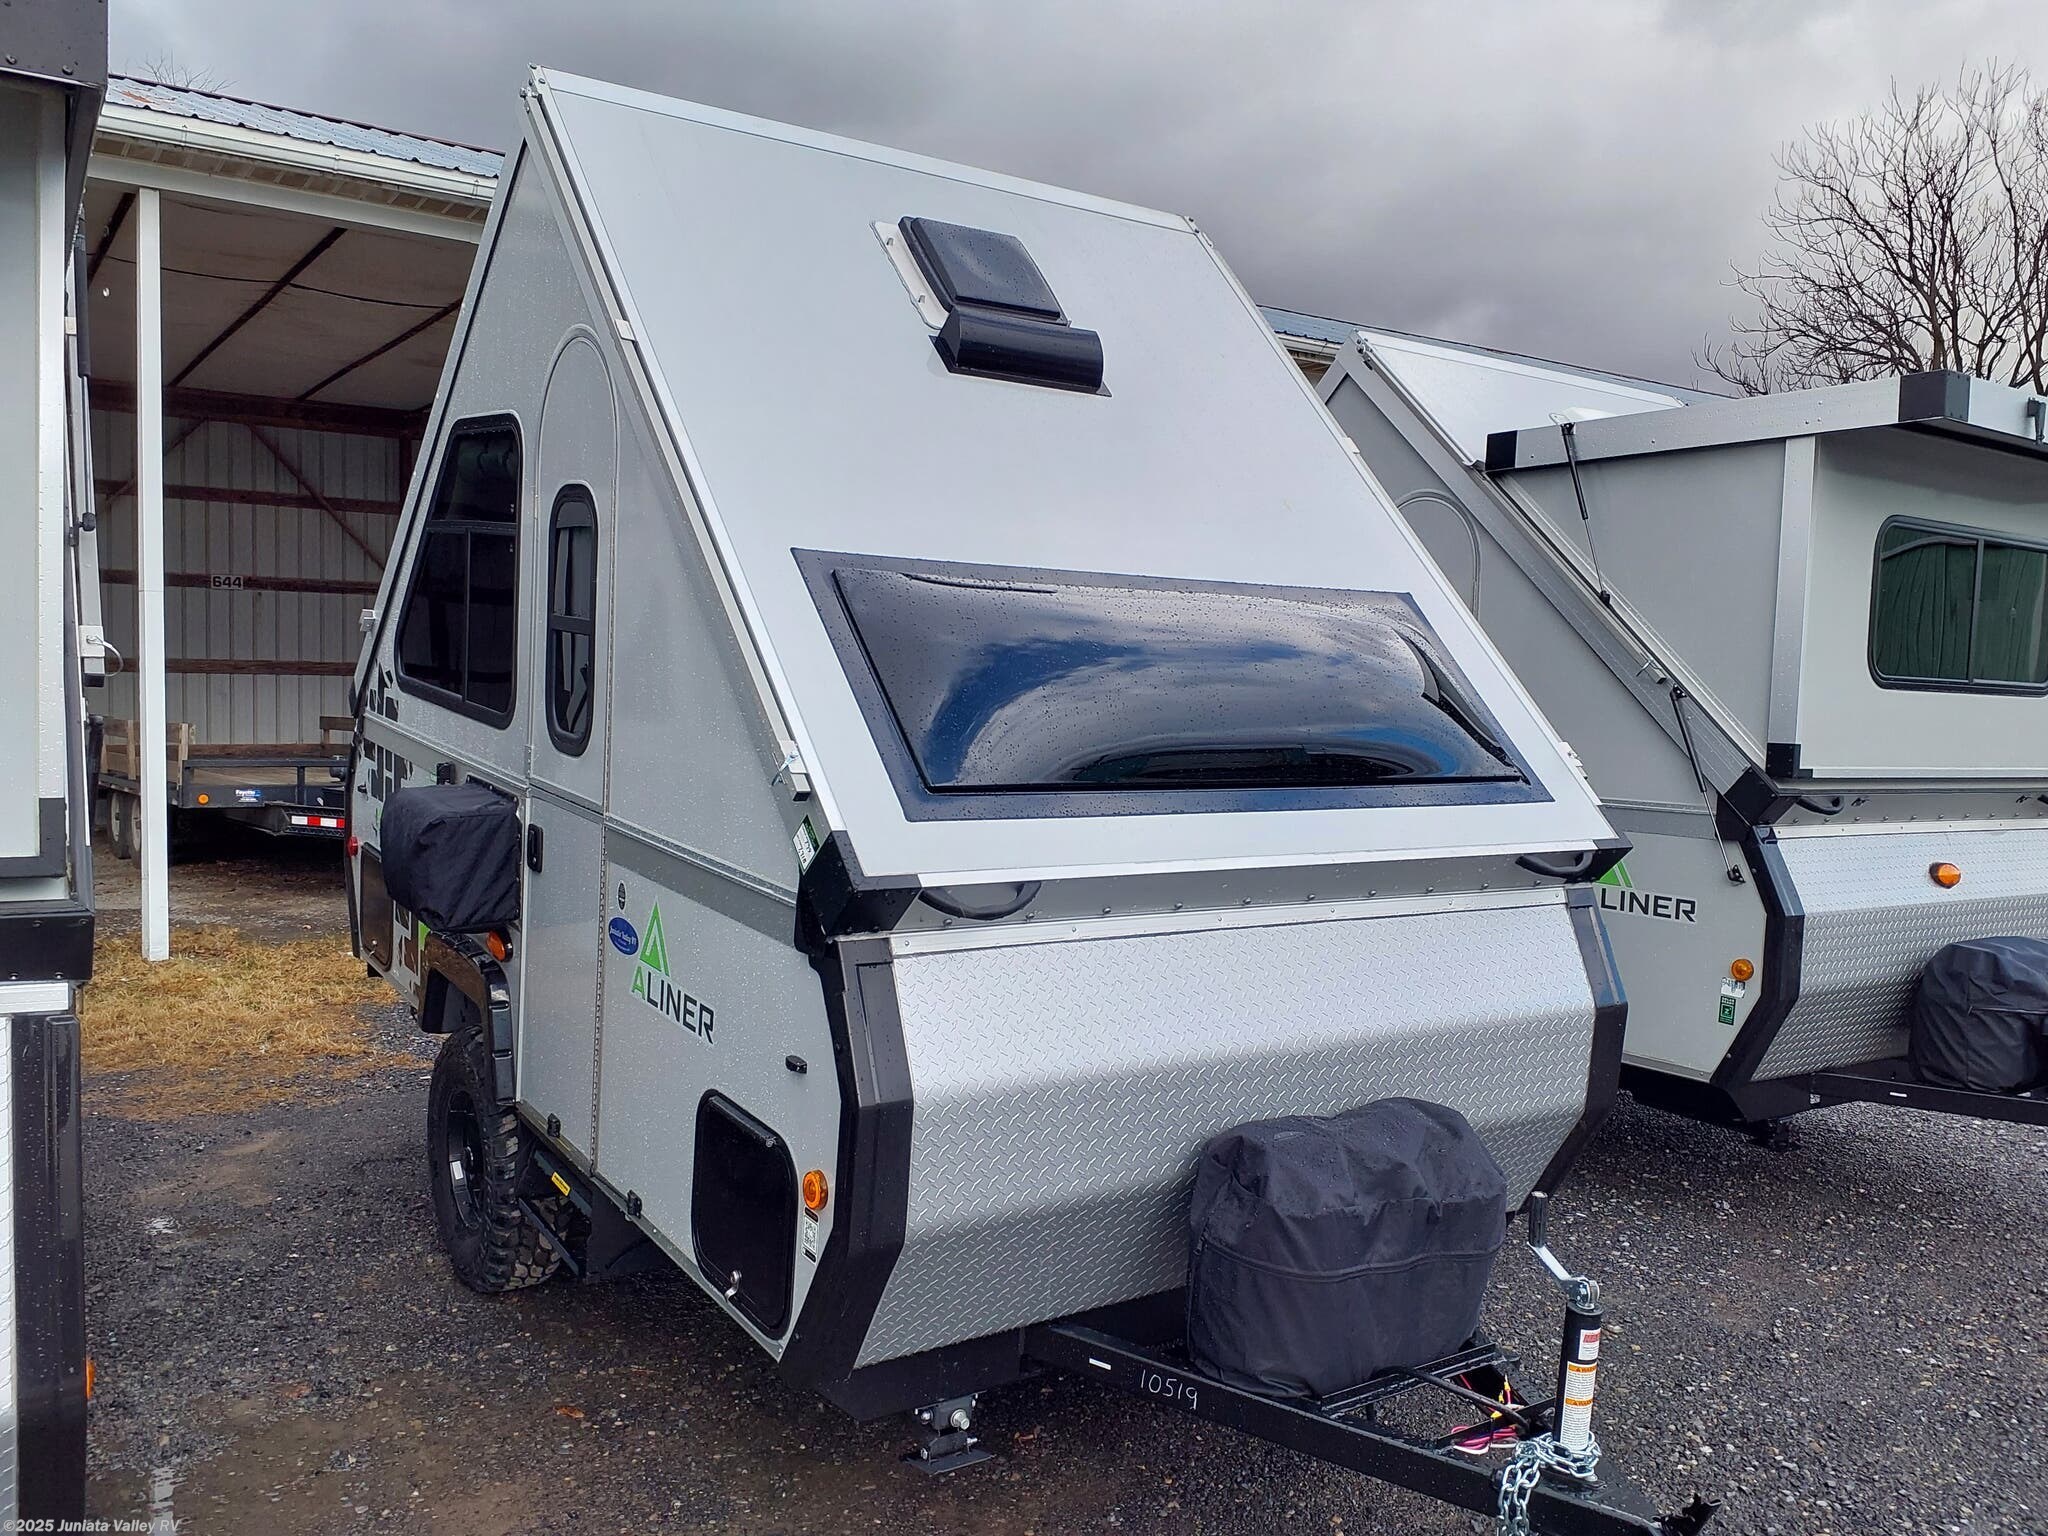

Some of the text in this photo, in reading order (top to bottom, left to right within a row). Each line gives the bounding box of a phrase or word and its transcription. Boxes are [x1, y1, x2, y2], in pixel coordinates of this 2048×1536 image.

[212, 576, 242, 588] 644
[1601, 888, 1696, 922] LINER
[631, 966, 714, 1045] ALINER
[1140, 1369, 1198, 1410] 10519
